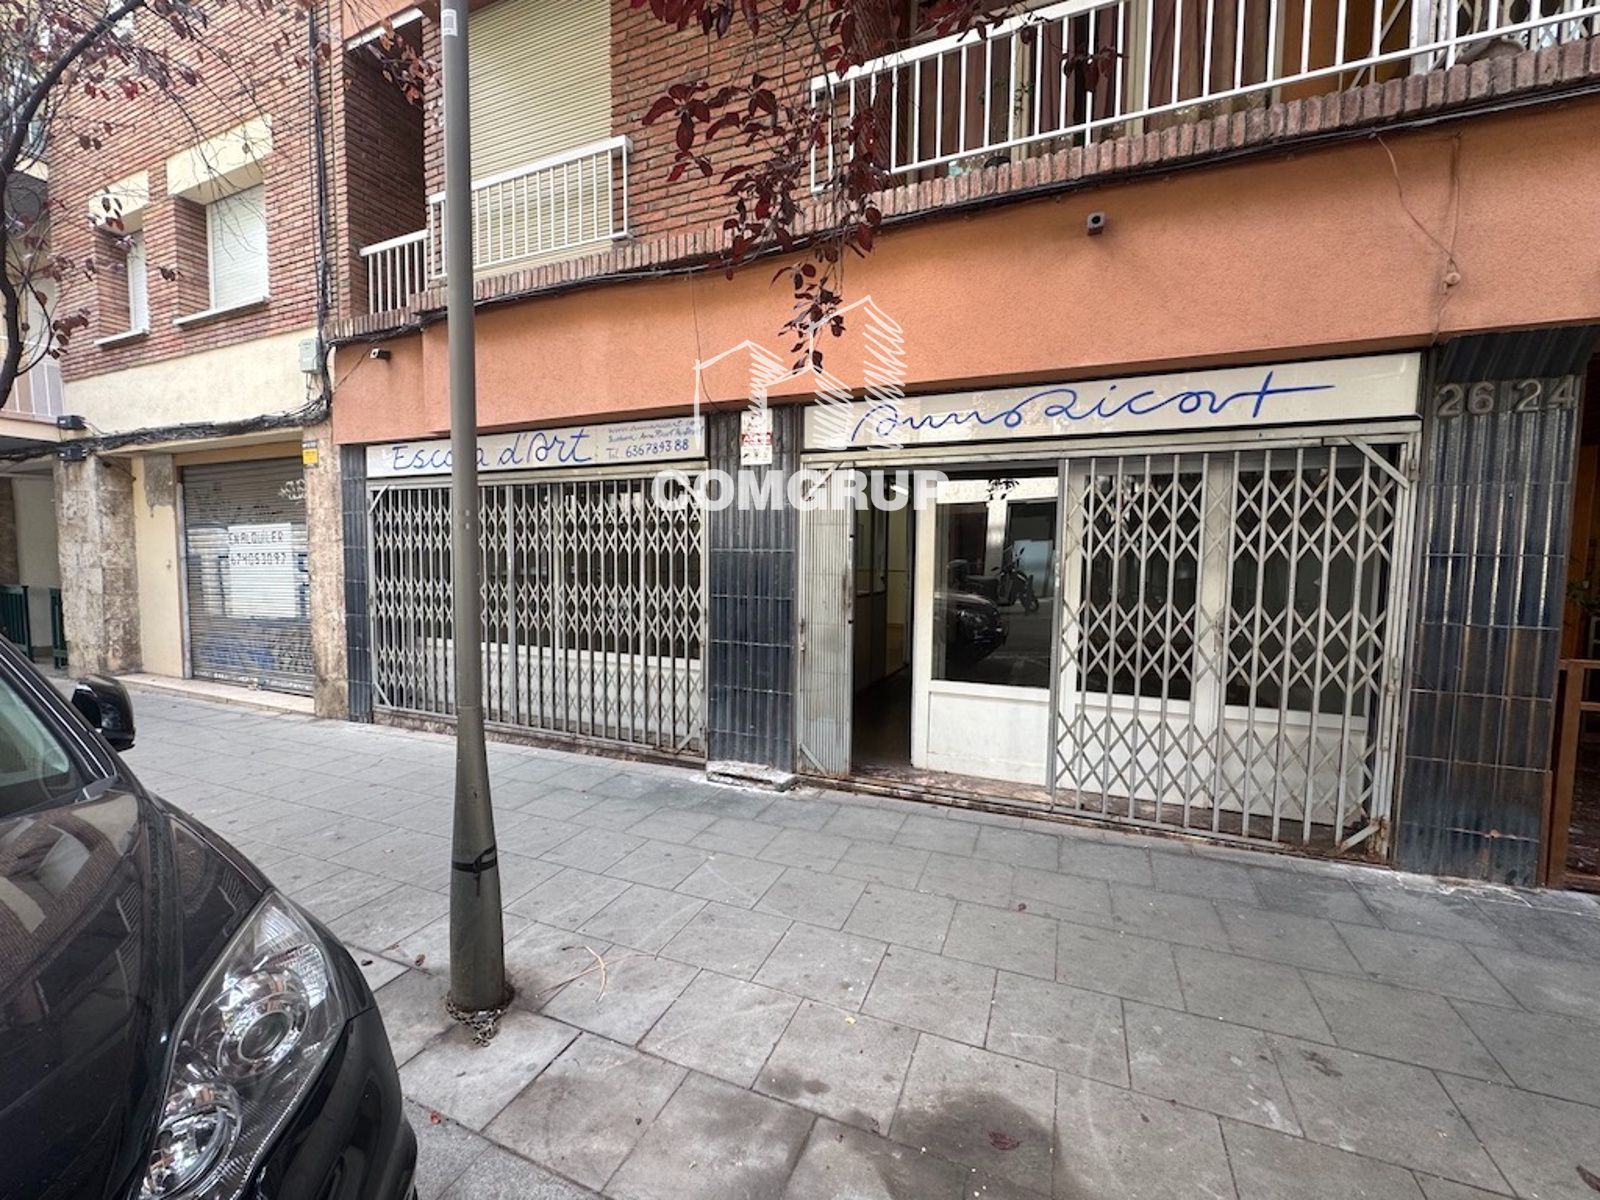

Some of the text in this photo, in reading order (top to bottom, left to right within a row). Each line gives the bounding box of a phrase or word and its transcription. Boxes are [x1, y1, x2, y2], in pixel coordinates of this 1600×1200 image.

[1437, 374, 1576, 417] 26 24
[392, 428, 592, 471] Escoa d'Art
